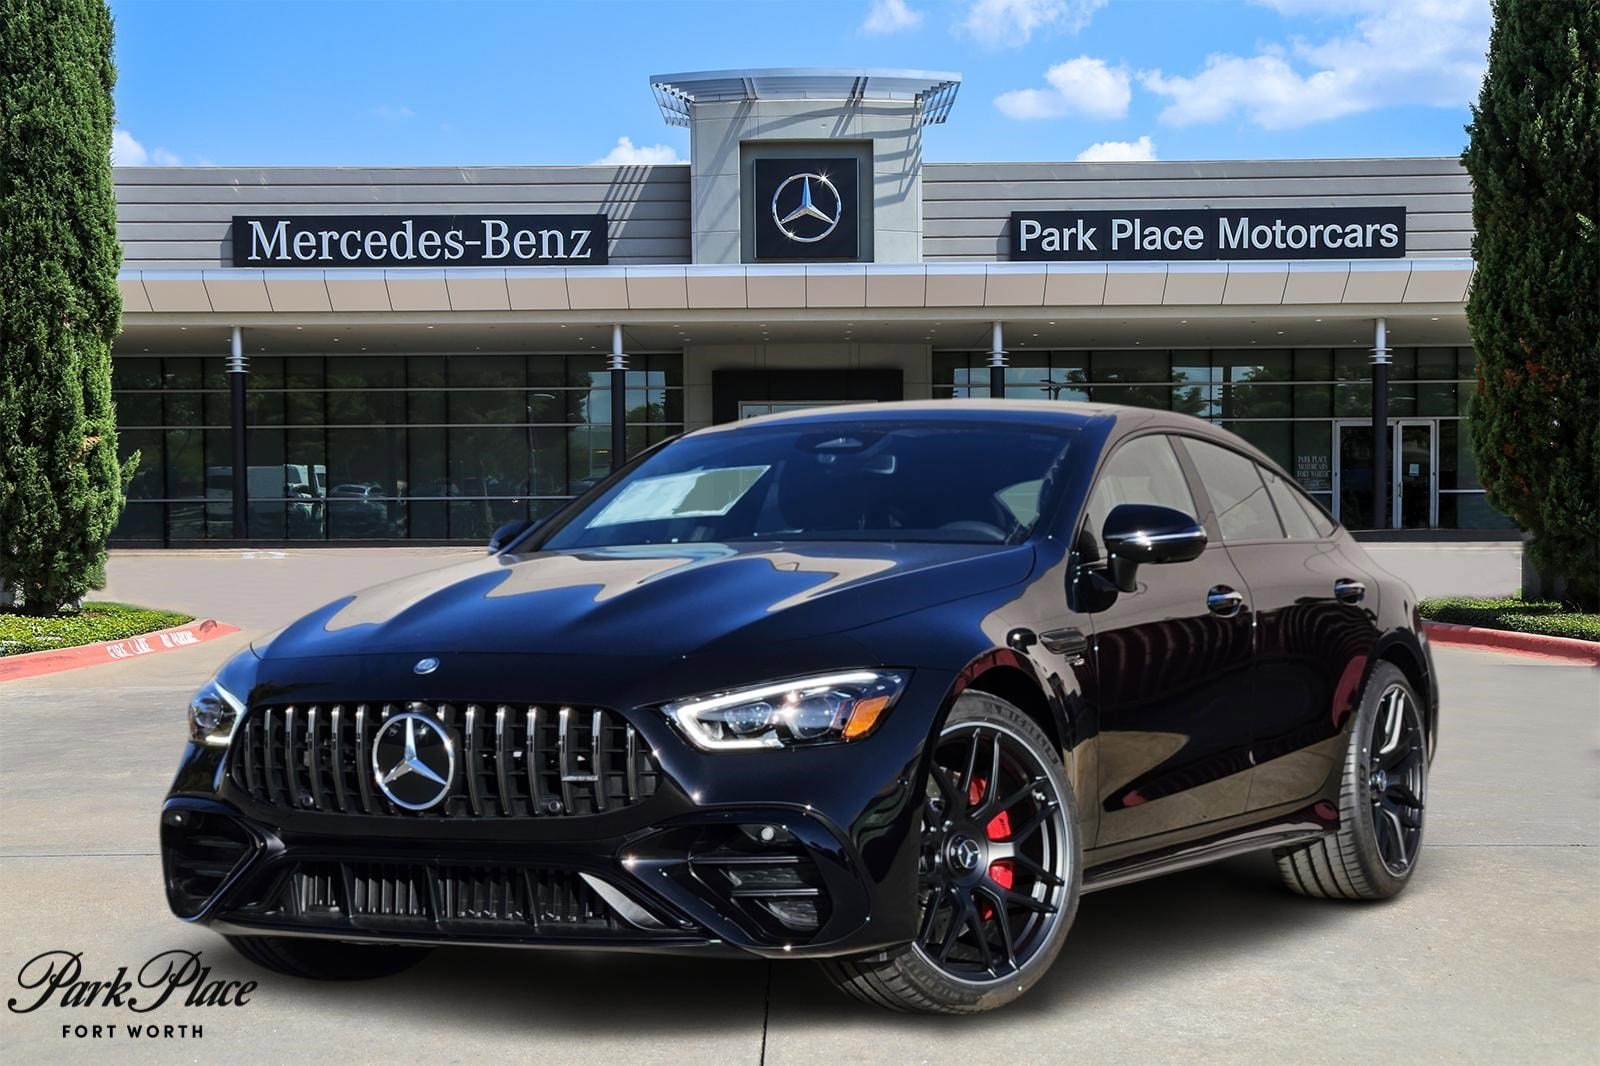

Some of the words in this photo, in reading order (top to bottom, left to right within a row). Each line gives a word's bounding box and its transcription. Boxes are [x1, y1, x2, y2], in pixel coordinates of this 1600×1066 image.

[247, 219, 592, 261] Mercedes-Benz
[1019, 218, 1098, 252] Park
[1111, 218, 1204, 251] Place
[1217, 216, 1400, 249] Motorcars
